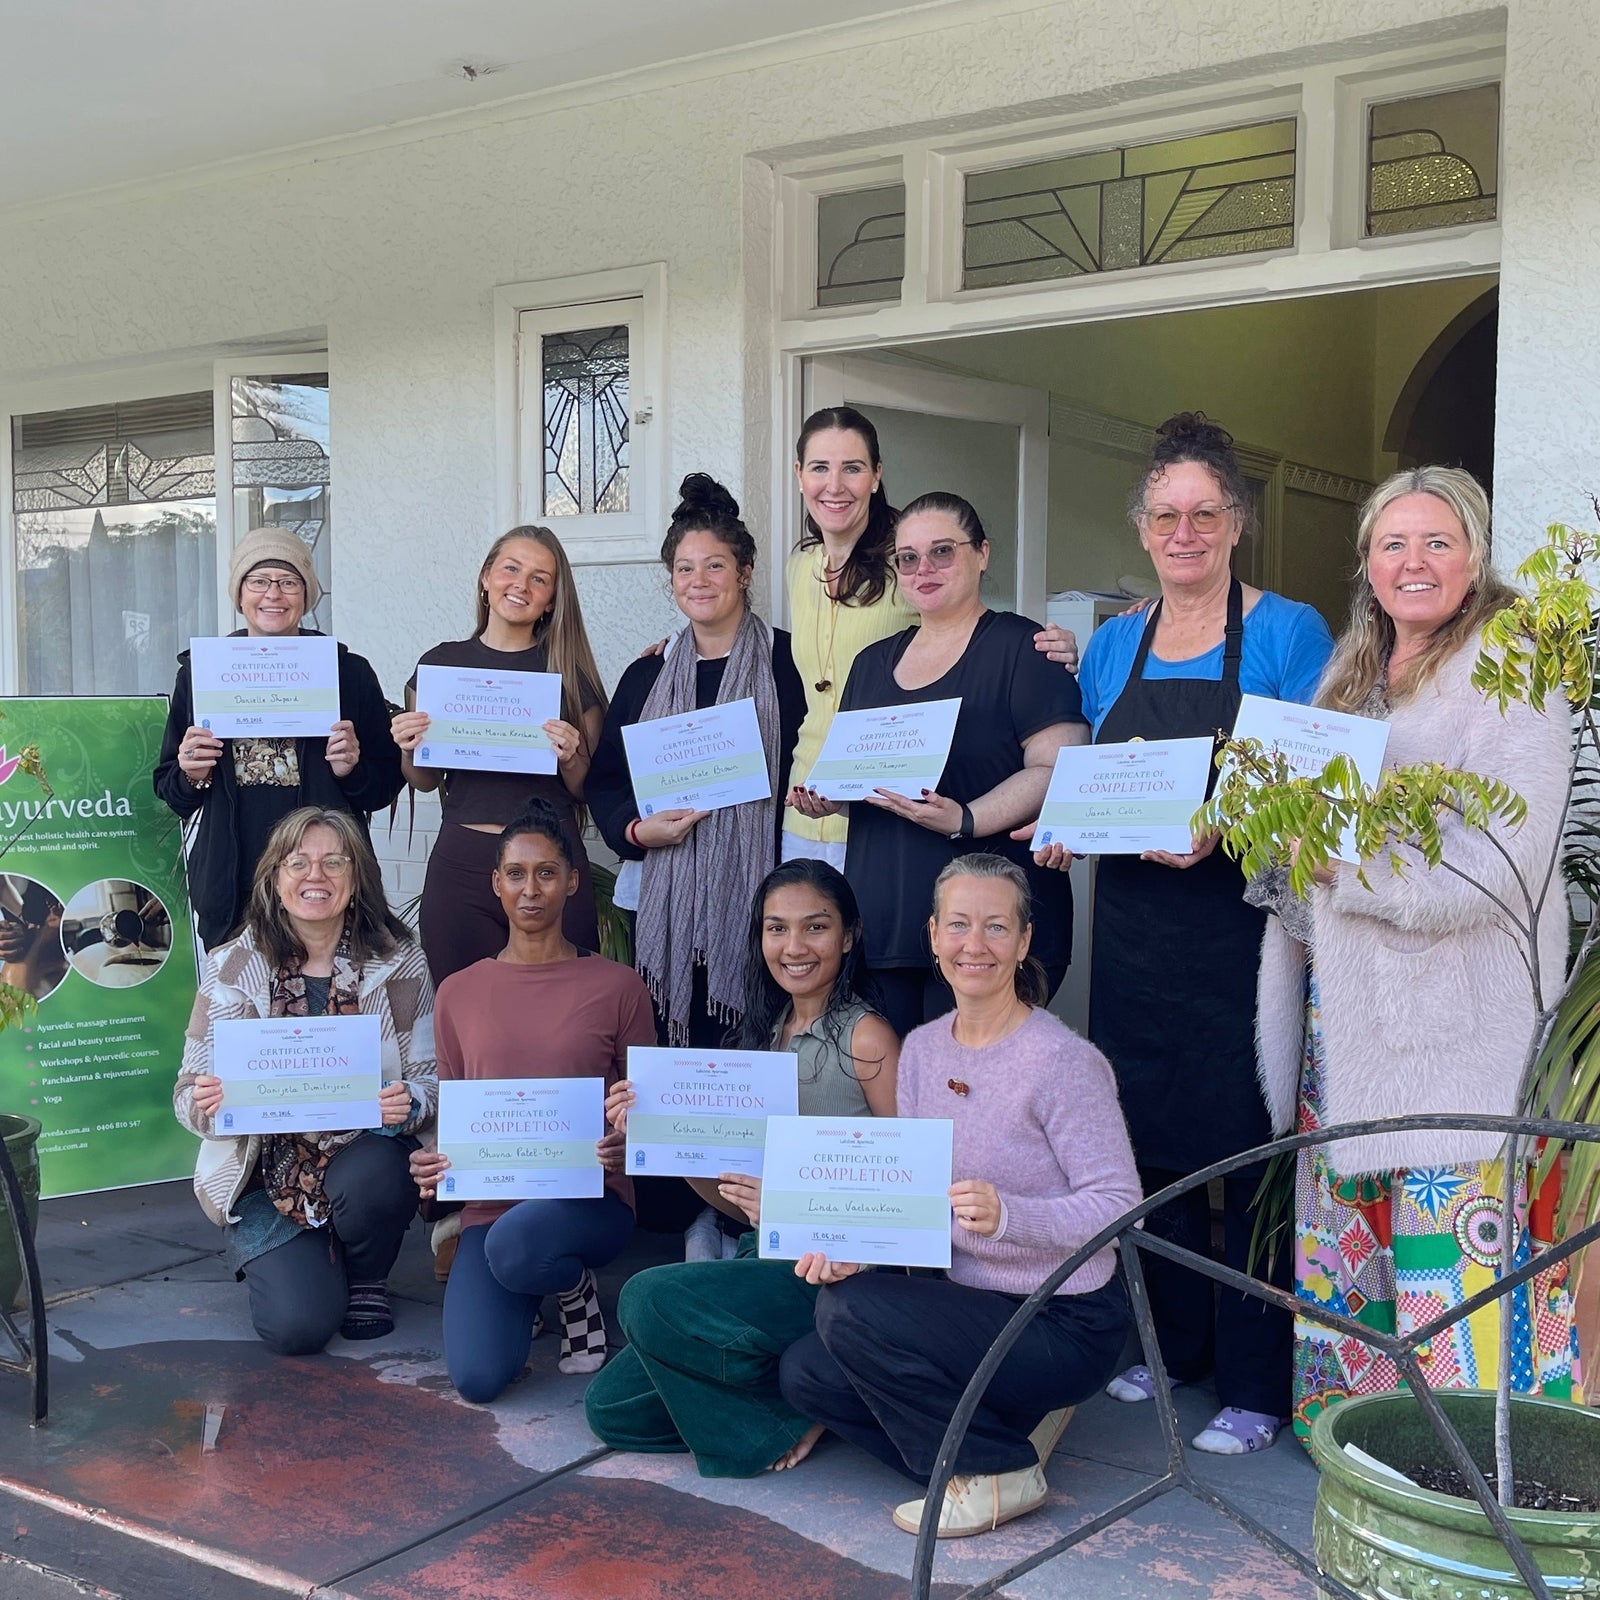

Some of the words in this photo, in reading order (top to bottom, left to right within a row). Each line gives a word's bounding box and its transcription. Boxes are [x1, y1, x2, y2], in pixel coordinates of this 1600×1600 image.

[221, 672, 310, 683] COMPLETION
[455, 694, 508, 704] CERTIFICATE
[444, 703, 532, 717] COMPLETION
[663, 735, 712, 751] CERTIFICATE
[713, 731, 724, 740] OF
[859, 730, 908, 741] CERTIFICATE
[909, 729, 919, 737] OF
[654, 739, 736, 765] COMPLETION
[846, 738, 927, 753] COMPLETION
[1093, 771, 1150, 781] CERTIFICATE
[1152, 770, 1165, 778] OF
[1079, 780, 1176, 794] COMPLETION
[0, 790, 133, 828] yurveda
[35, 831, 64, 840] holistic
[66, 830, 90, 840] health
[40, 843, 60, 852] mind
[62, 842, 77, 850] and
[37, 1022, 74, 1033] Ayurvedic
[76, 1019, 107, 1029] massage
[109, 1015, 146, 1025] treatment
[38, 1039, 60, 1050] Facial
[61, 1039, 76, 1048] and
[78, 1037, 103, 1046] beauty
[105, 1033, 141, 1043] treatment
[260, 1047, 321, 1056] CERTIFICATE
[324, 1046, 336, 1054] OF
[40, 1056, 83, 1068] Workshops
[93, 1051, 129, 1063] Ayurvedic
[131, 1049, 160, 1058] courses
[247, 1056, 349, 1071] COMPLETION
[42, 1074, 93, 1085] Panchakarma
[103, 1068, 149, 1079] rejuvenation
[673, 1082, 736, 1092] CERTIFICATE
[738, 1084, 752, 1092] OF
[43, 1095, 62, 1104] Yoga
[660, 1093, 765, 1109] COMPLETION
[483, 1110, 543, 1119] CERTIFICATE
[546, 1109, 559, 1117] OF
[96, 1123, 115, 1132] 0406
[115, 1121, 128, 1129] 810
[470, 1120, 571, 1134] COMPLETION
[813, 1153, 882, 1164] CERTIFICATE
[885, 1155, 900, 1164] OF
[798, 1166, 913, 1183] COMPLETION
[808, 1198, 839, 1212] Linda
